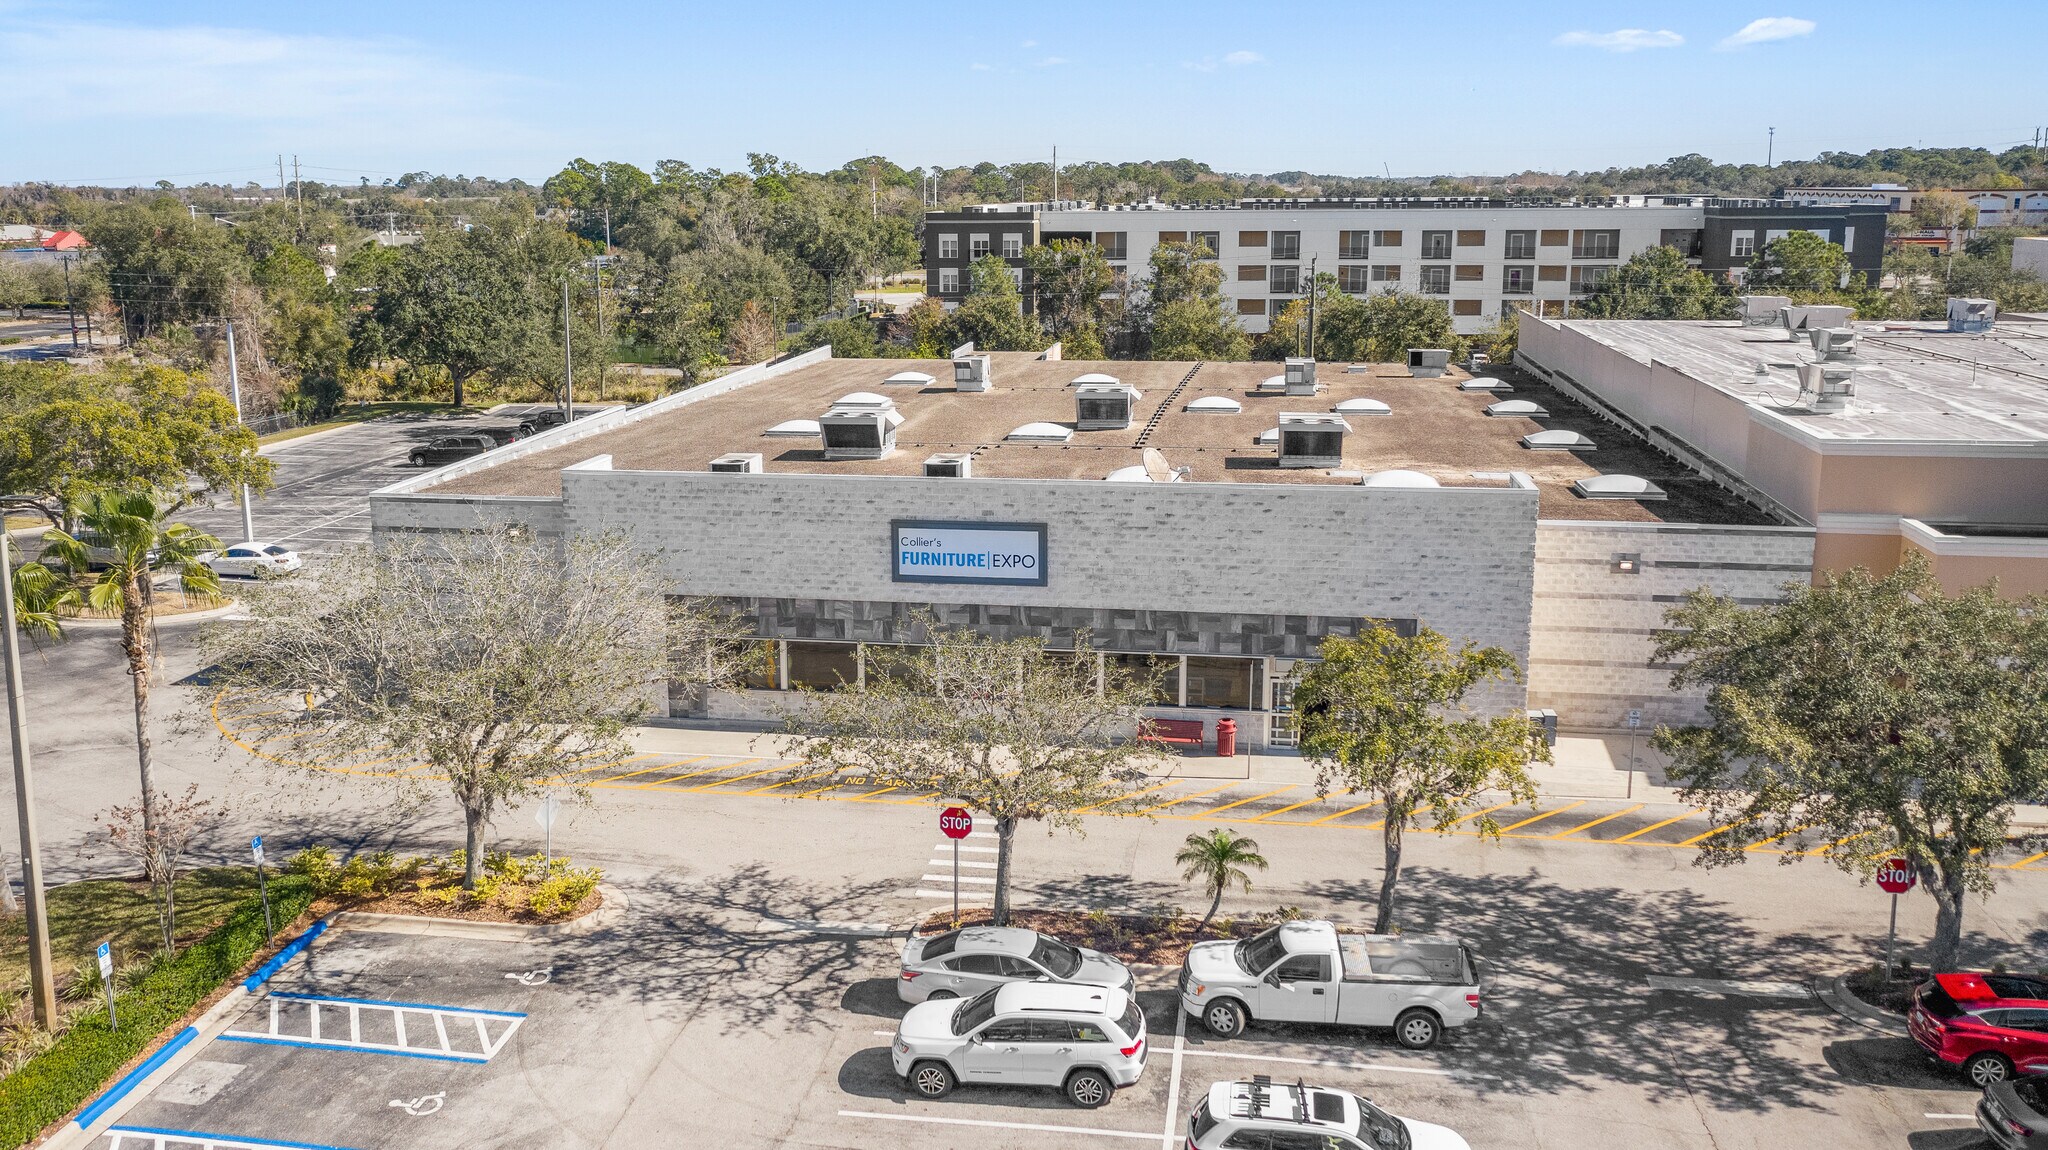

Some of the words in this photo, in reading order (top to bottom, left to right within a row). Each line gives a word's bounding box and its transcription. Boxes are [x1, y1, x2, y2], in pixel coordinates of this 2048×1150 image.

[901, 537, 942, 547] Collier's
[902, 552, 986, 567] FURNITURE
[993, 554, 1036, 568] EXPO
[873, 778, 938, 787] PARKG
[941, 816, 970, 830] STOP
